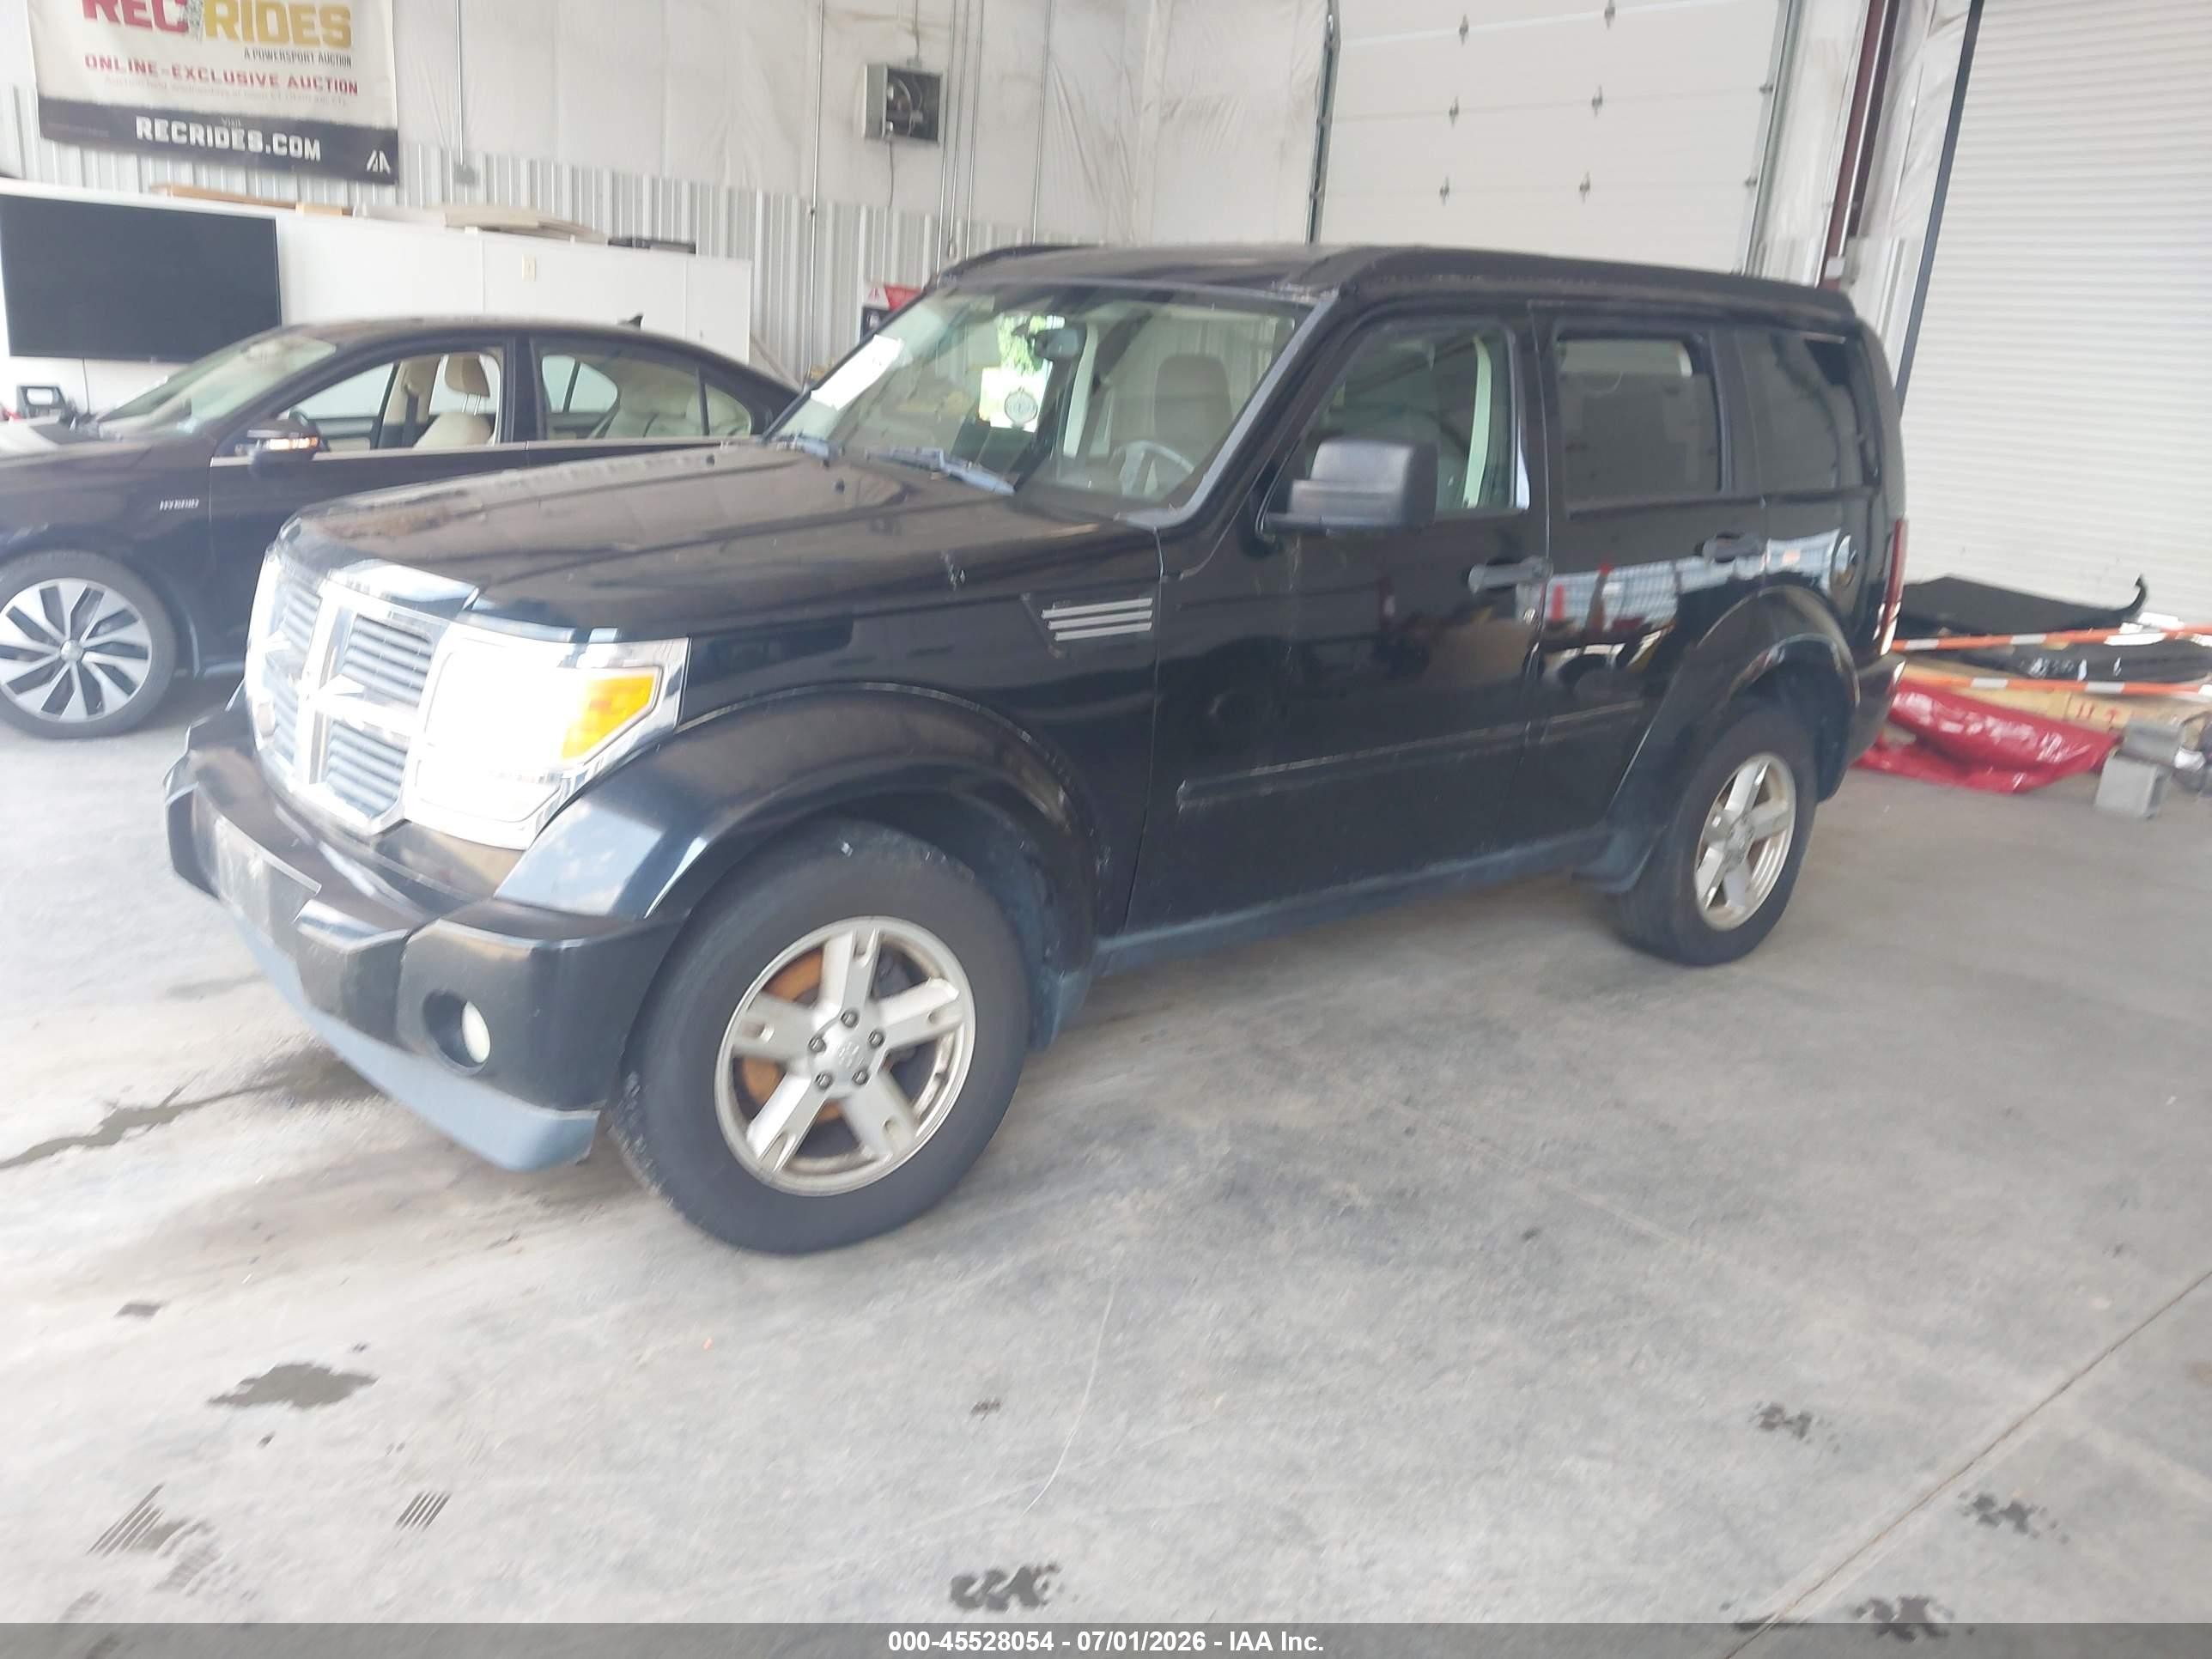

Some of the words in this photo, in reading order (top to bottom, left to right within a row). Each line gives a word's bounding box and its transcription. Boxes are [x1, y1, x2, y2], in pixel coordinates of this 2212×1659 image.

[204, 0, 352, 49] RIDES
[84, 54, 280, 88] ONLINE-EXCLUSIVE
[288, 74, 359, 97] AUCTION
[244, 47, 251, 60] A
[252, 48, 315, 64] POWERSPORT
[317, 52, 353, 69] AUCTION
[135, 115, 321, 162] RECRIDES.COM
